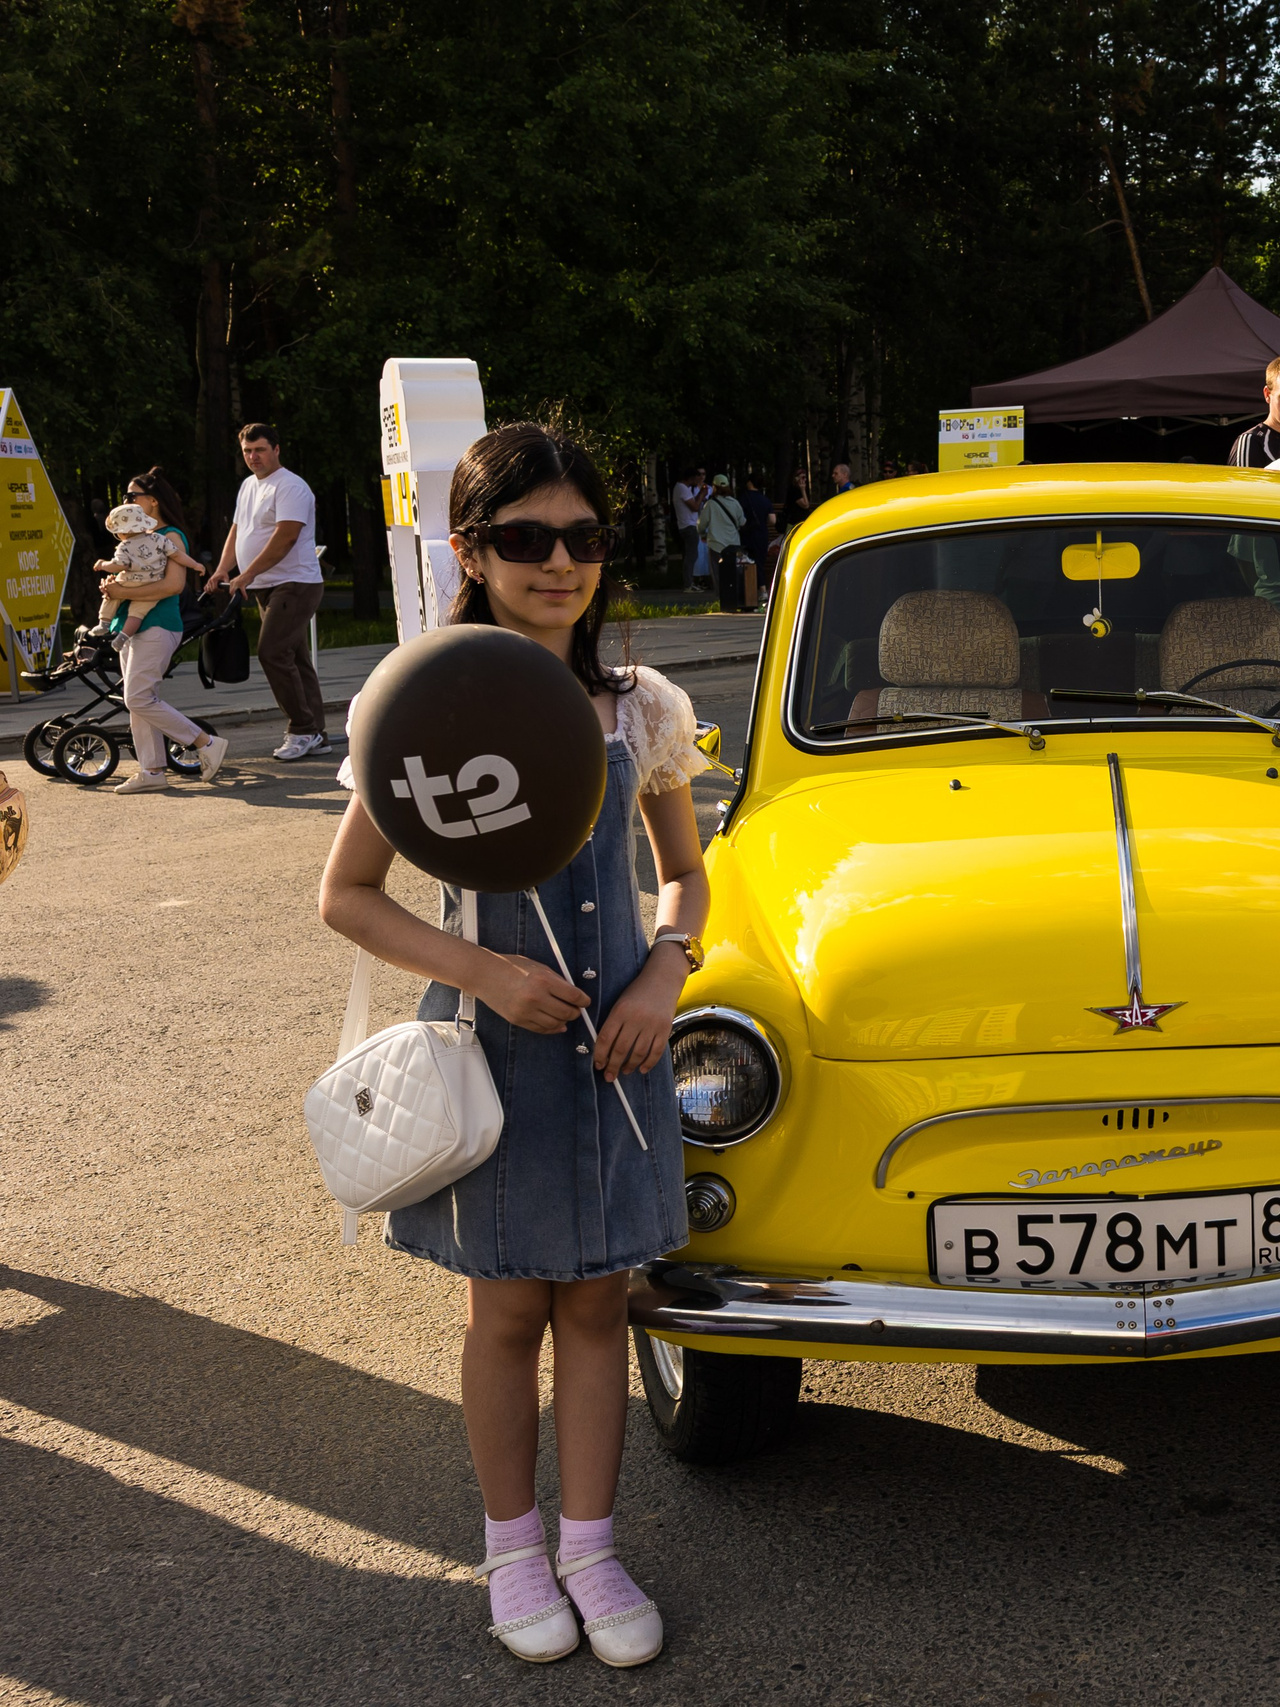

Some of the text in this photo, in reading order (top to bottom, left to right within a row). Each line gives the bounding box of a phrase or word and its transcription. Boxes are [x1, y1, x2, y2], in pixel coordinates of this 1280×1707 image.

[17, 550, 40, 571] КОФЕ
[6, 574, 55, 599] ПО-НЕНЕЦКИ
[390, 754, 532, 839] t2
